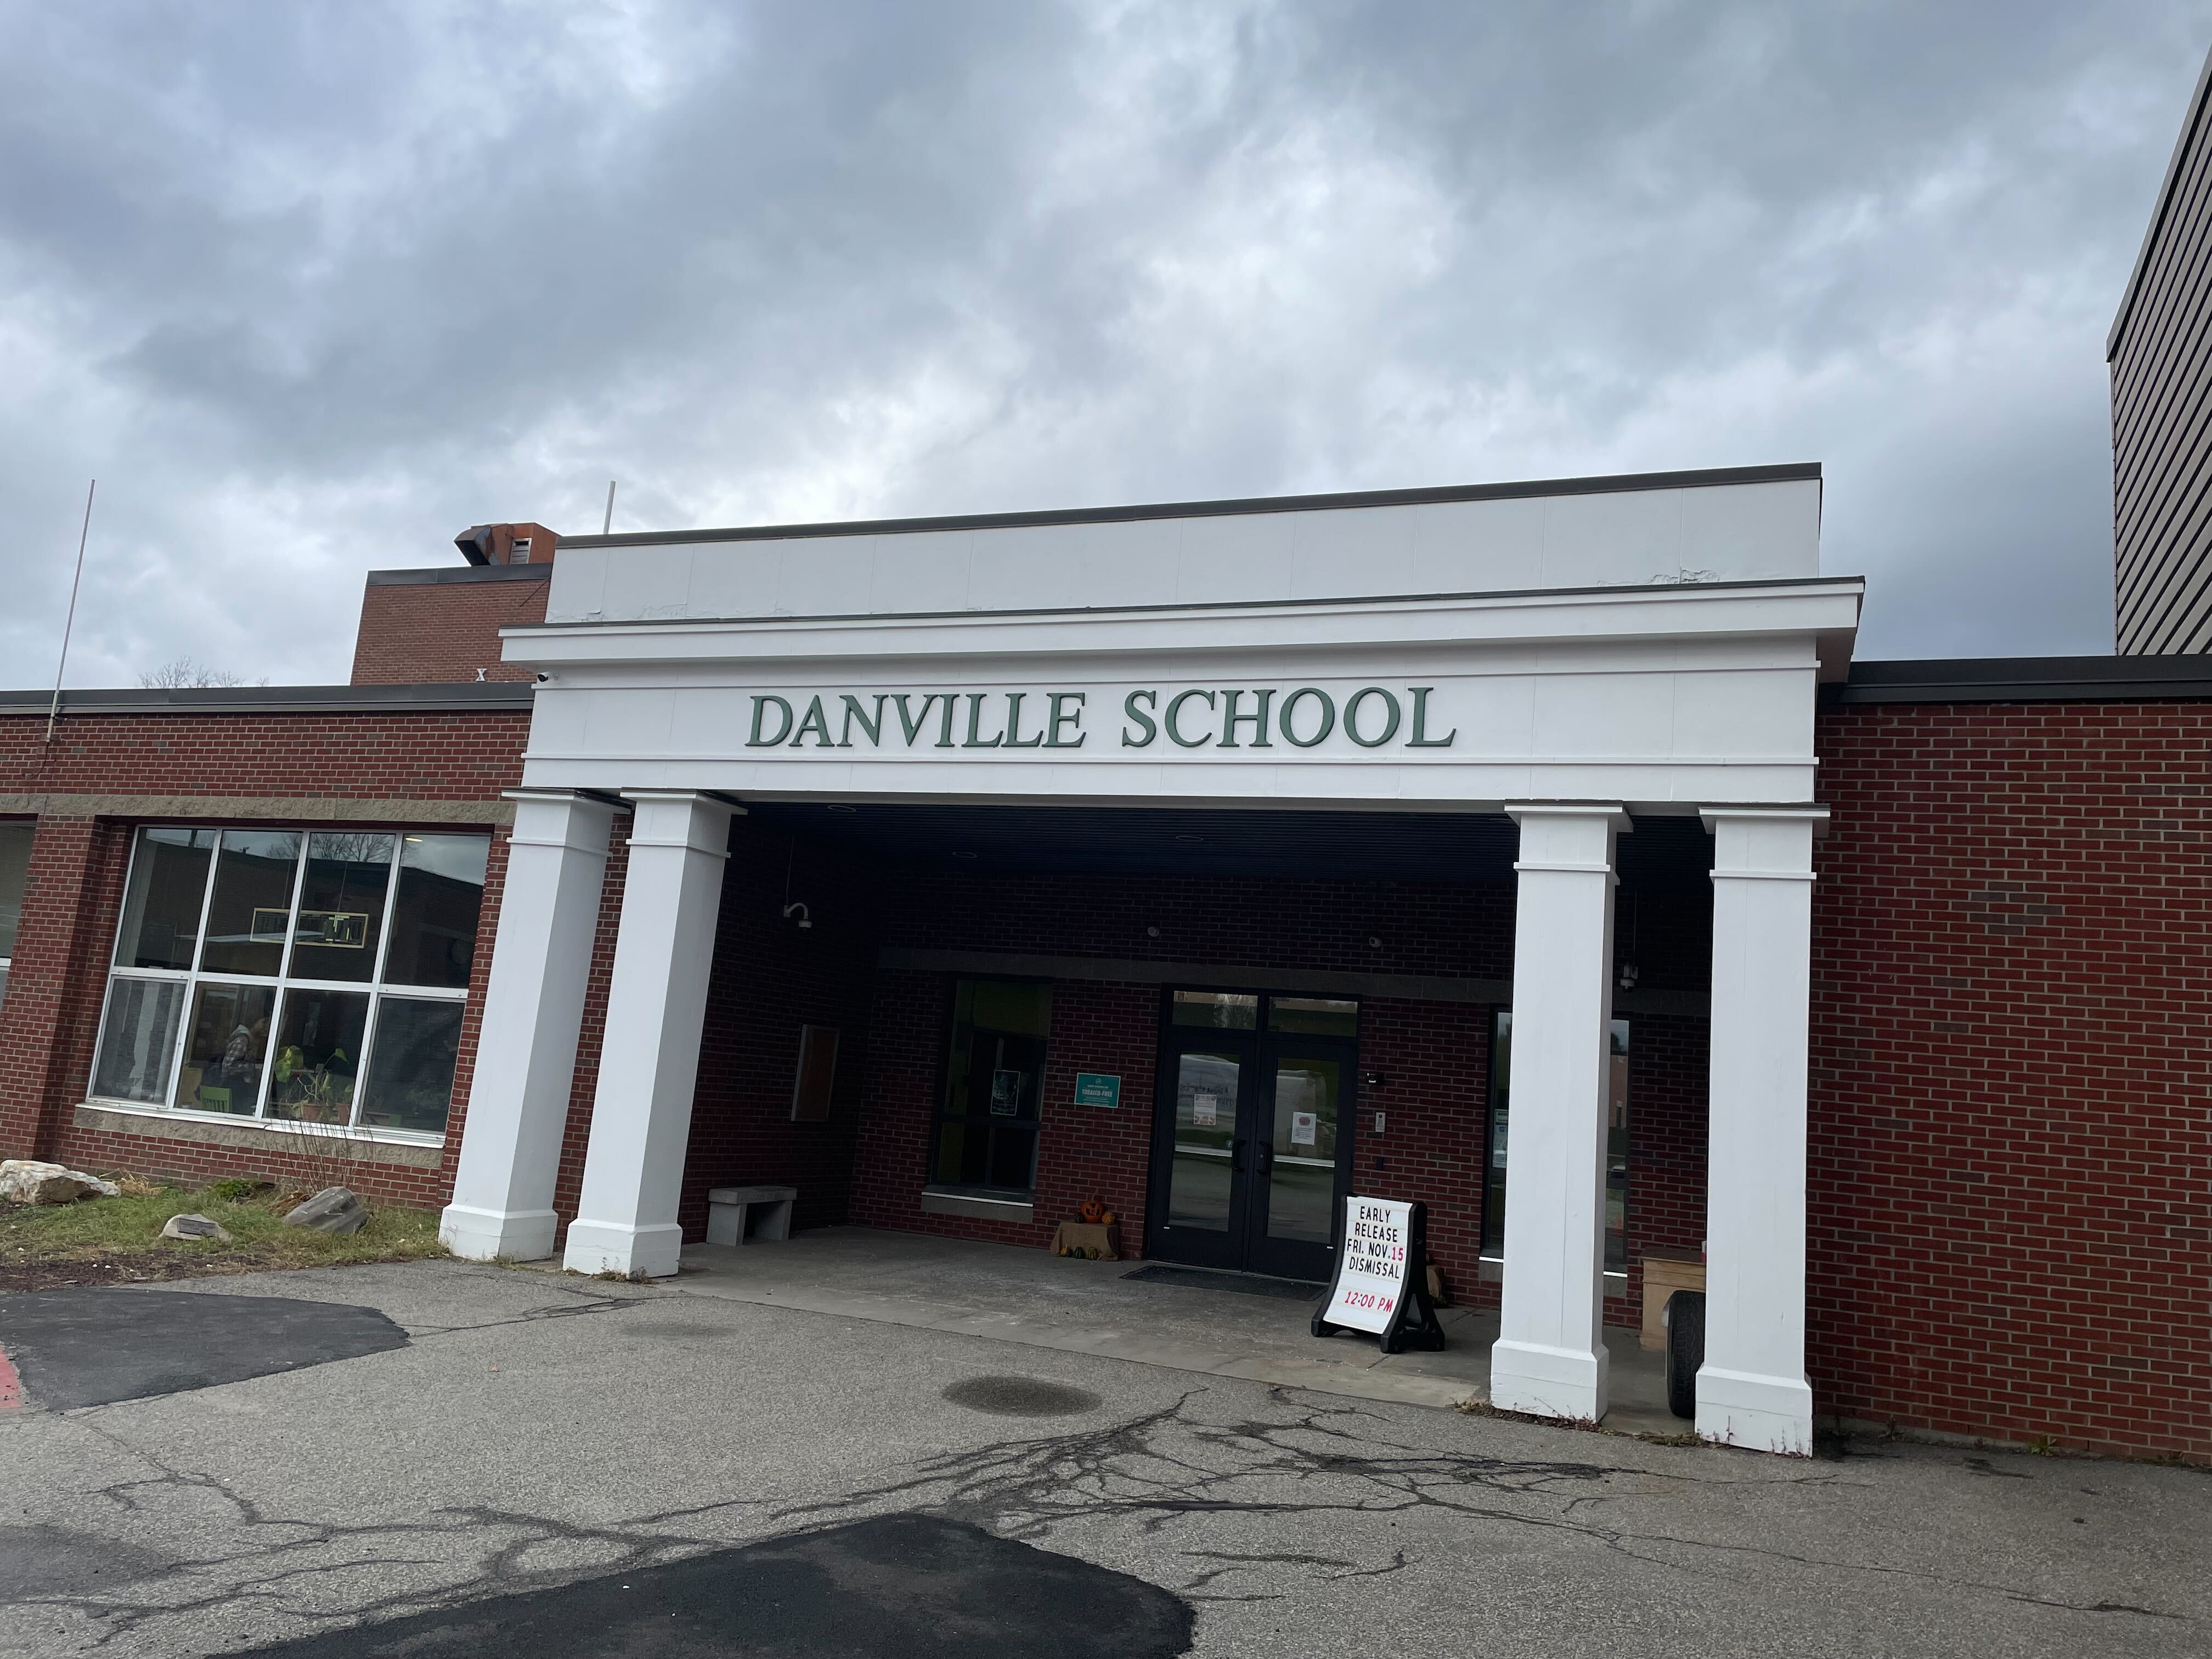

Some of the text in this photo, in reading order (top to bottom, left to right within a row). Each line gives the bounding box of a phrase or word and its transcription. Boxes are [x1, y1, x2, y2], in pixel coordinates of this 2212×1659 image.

[744, 687, 1457, 748] DANVILLE SCHOOL
[1082, 1088, 1113, 1097] TOBACCO-FREE
[1360, 1206, 1390, 1223] EARLY
[1355, 1222, 1397, 1243] RELEASE
[1347, 1238, 1363, 1254] FRI.
[1349, 1256, 1400, 1279] DISMISSAL
[1345, 1291, 1393, 1312] 12:00 PM
